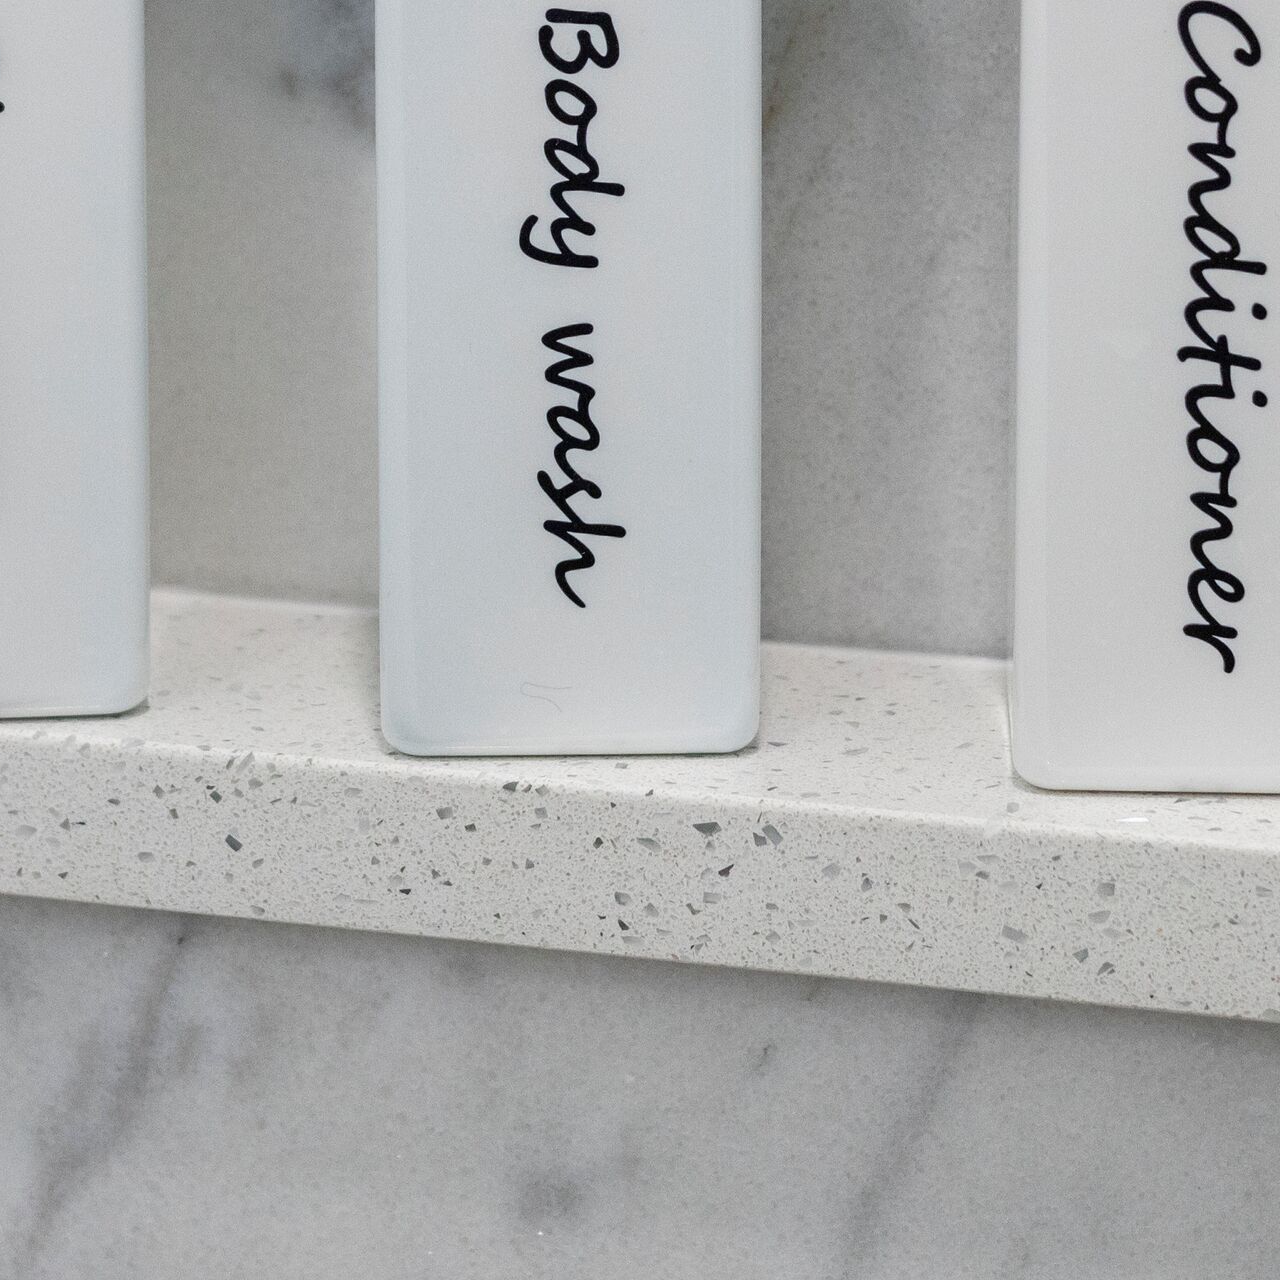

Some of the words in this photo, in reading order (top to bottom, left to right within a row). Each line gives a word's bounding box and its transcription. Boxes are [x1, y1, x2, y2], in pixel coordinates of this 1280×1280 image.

[519, 8, 626, 269] Body
[537, 323, 627, 609] wash
[1177, 0, 1269, 674] Conditioner
